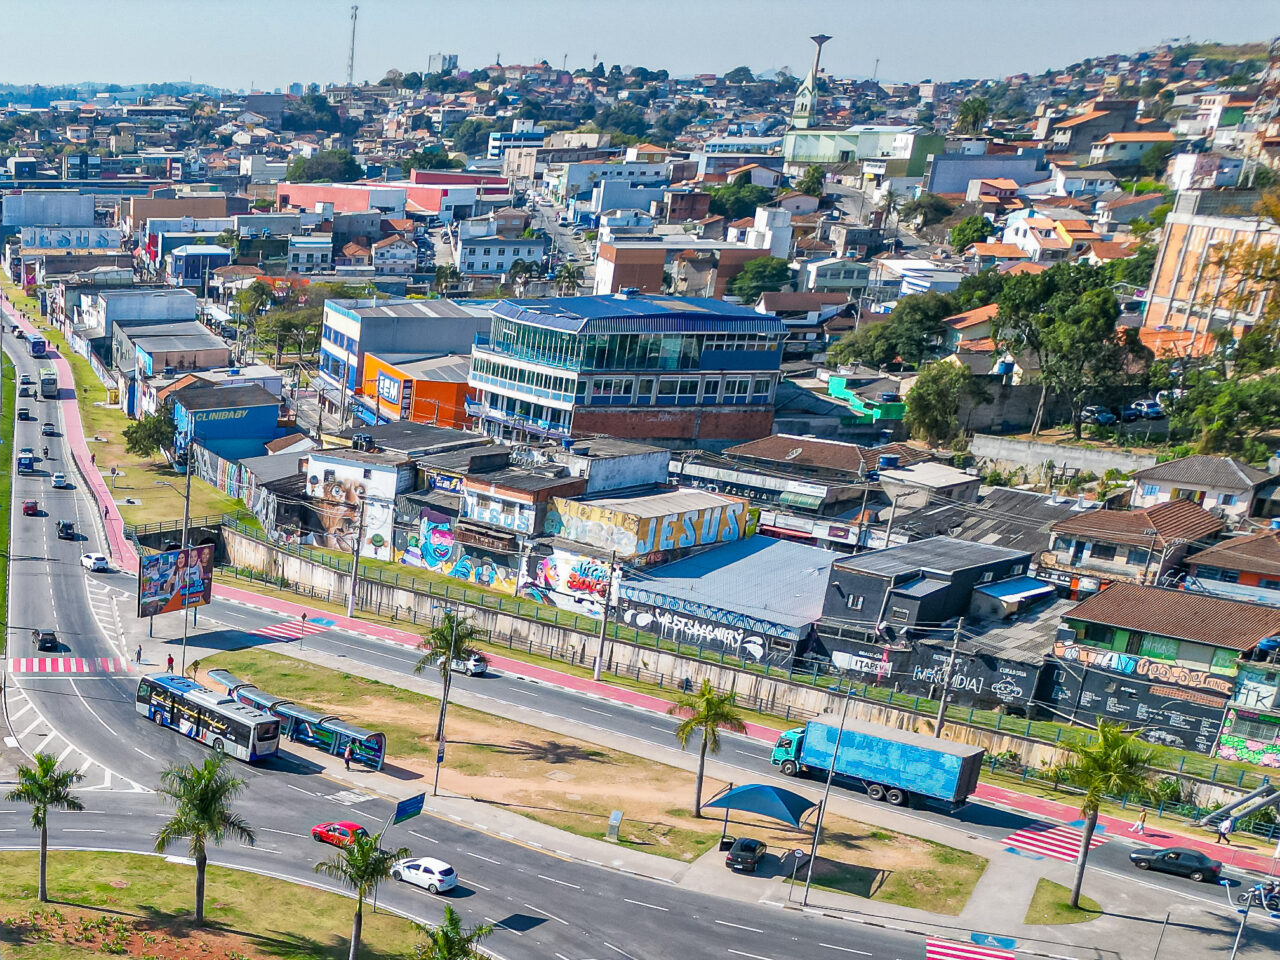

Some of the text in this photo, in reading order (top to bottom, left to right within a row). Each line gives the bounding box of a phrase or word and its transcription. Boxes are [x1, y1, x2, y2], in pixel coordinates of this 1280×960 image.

[23, 230, 109, 248] JESUS
[195, 409, 249, 422] CLINIBABY
[636, 502, 744, 554] JESUS
[1206, 679, 1227, 691] KING
